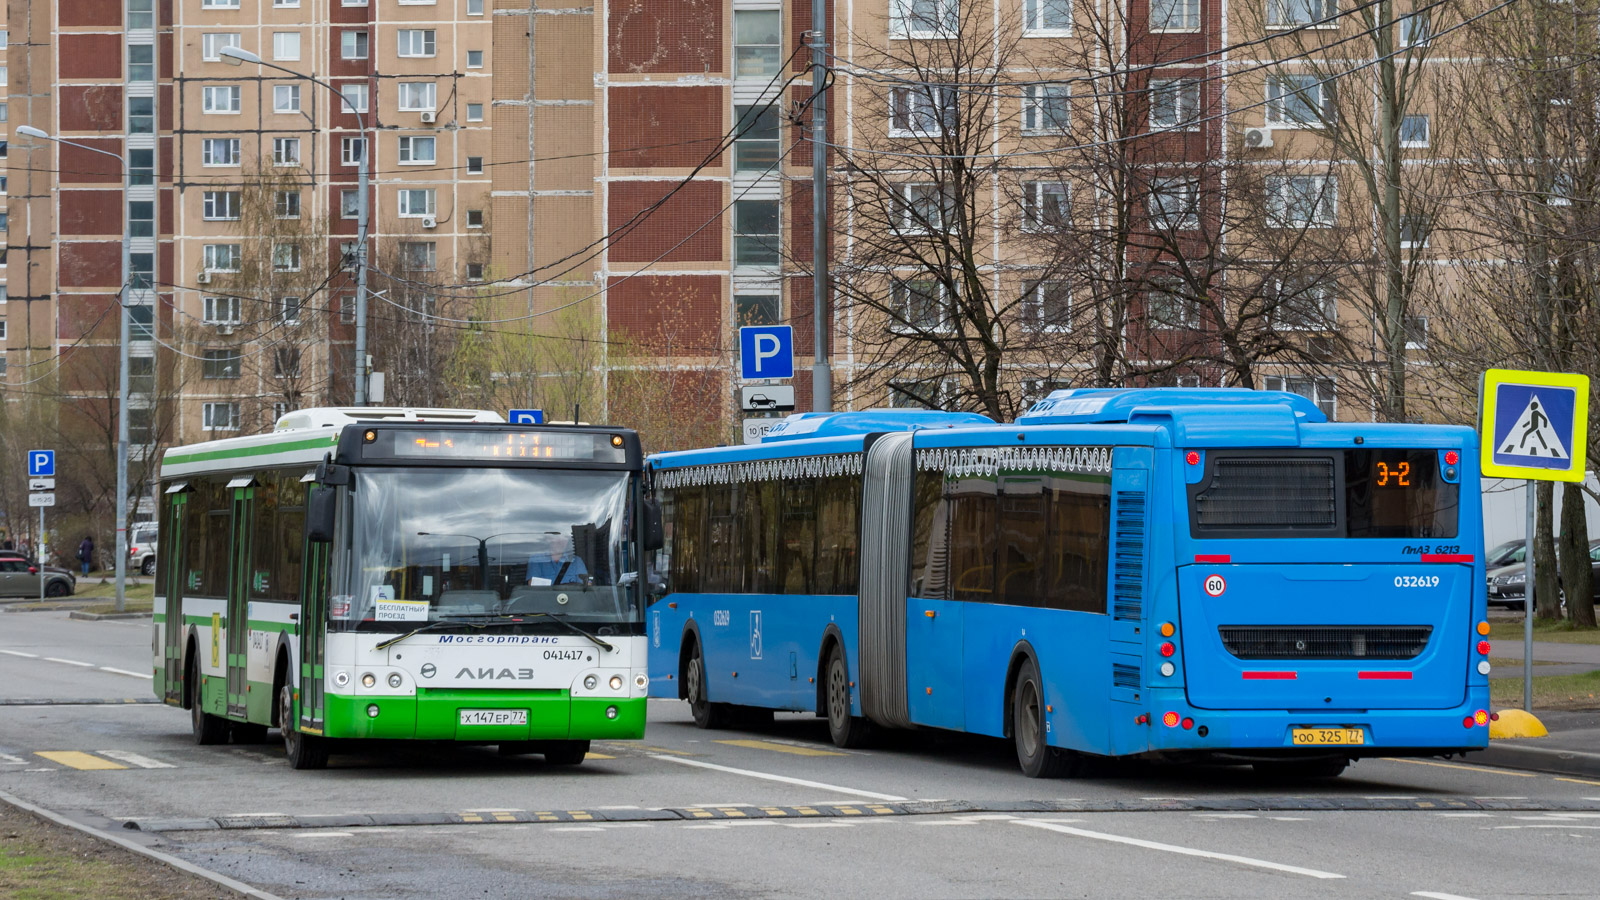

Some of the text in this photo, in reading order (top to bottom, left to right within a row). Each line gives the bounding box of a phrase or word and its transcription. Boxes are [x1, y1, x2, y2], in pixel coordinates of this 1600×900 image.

[754, 333, 781, 372] P
[749, 427, 758, 436] 10
[35, 453, 49, 473] P
[1435, 545, 1459, 554] 6213
[1208, 580, 1222, 591] 60
[1394, 576, 1440, 588] 032619
[378, 604, 425, 613] БЕСПЛАТНЫЙ
[378, 612, 406, 620] ПРОЕЗД
[438, 635, 559, 644] Мосгортранс
[543, 650, 583, 661] 041417
[454, 667, 534, 680] ЛИАЗ
[512, 711, 524, 720] 77
[1319, 731, 1341, 742] 325
[1348, 730, 1359, 740] 77
